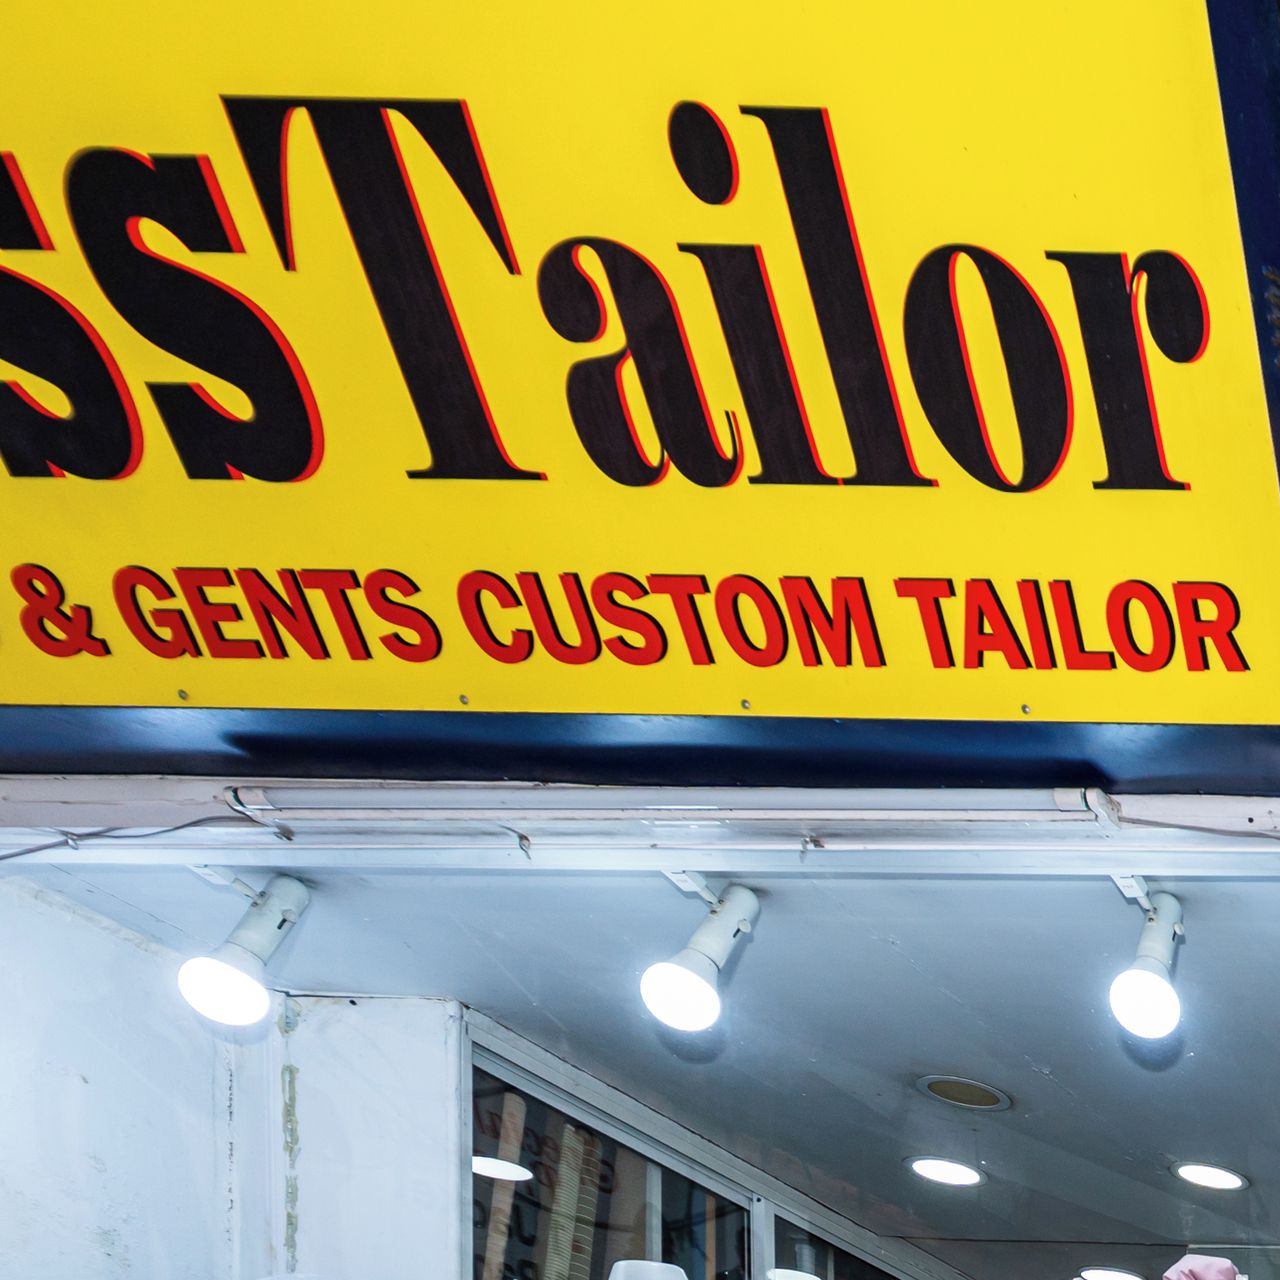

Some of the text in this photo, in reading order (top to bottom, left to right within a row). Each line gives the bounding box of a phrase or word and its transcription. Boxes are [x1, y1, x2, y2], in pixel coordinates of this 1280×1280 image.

[10, 562, 1251, 674] & GENTS CUSTOM TAILOR
